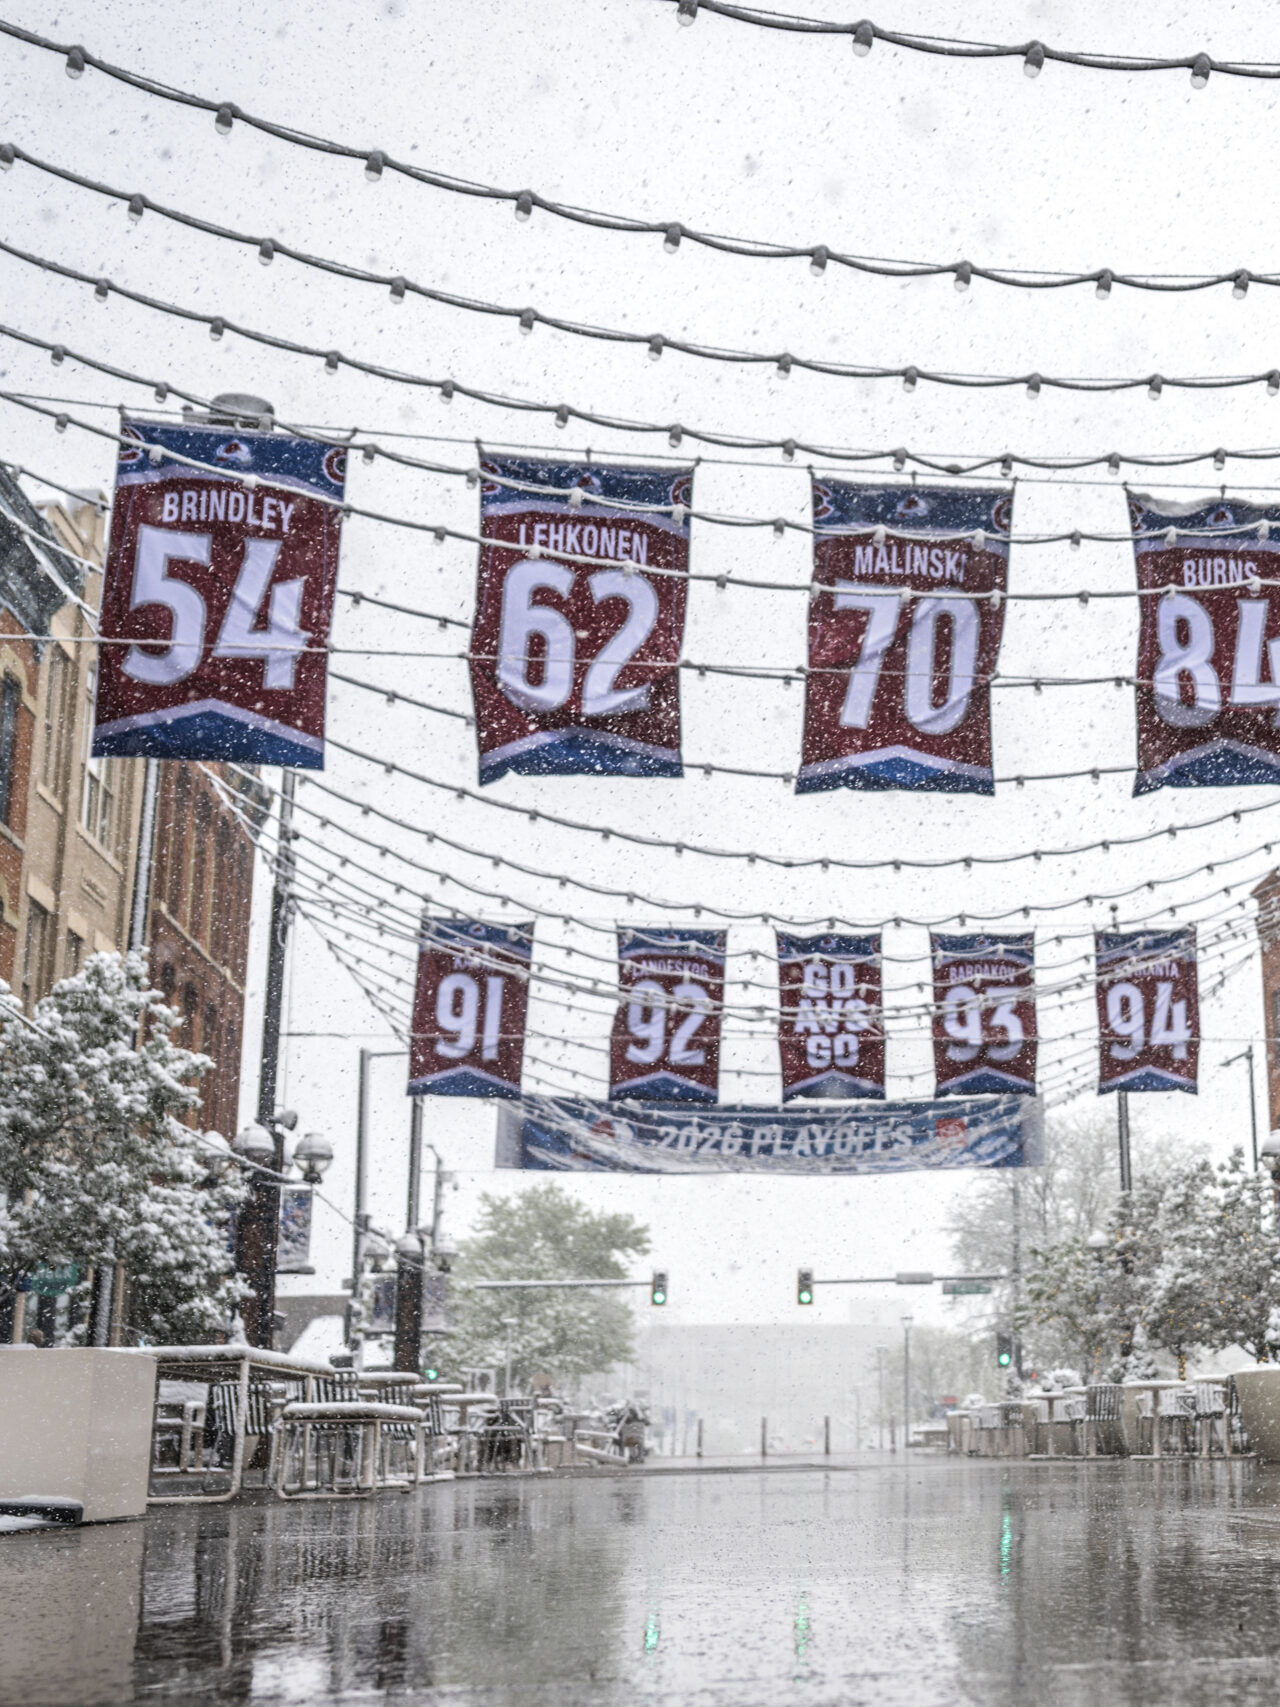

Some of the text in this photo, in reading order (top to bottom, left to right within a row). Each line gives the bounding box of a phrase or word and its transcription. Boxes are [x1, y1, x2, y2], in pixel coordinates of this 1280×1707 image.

[162, 489, 295, 534] BRINDLEY
[519, 523, 649, 565] LEHKONEN
[854, 545, 967, 583] MALINSKI
[1183, 558, 1259, 591] BURNS
[120, 523, 313, 690] 54
[496, 558, 659, 717] 62
[833, 577, 981, 736] 70
[804, 963, 855, 998] GO
[434, 972, 504, 1061] 91
[624, 979, 710, 1066] 92
[793, 998, 869, 1033] AVS
[944, 985, 1024, 1062] 93
[1106, 981, 1193, 1060] 94
[806, 1033, 860, 1068] GO
[657, 1123, 915, 1157] 2026 PLAYOFFS
